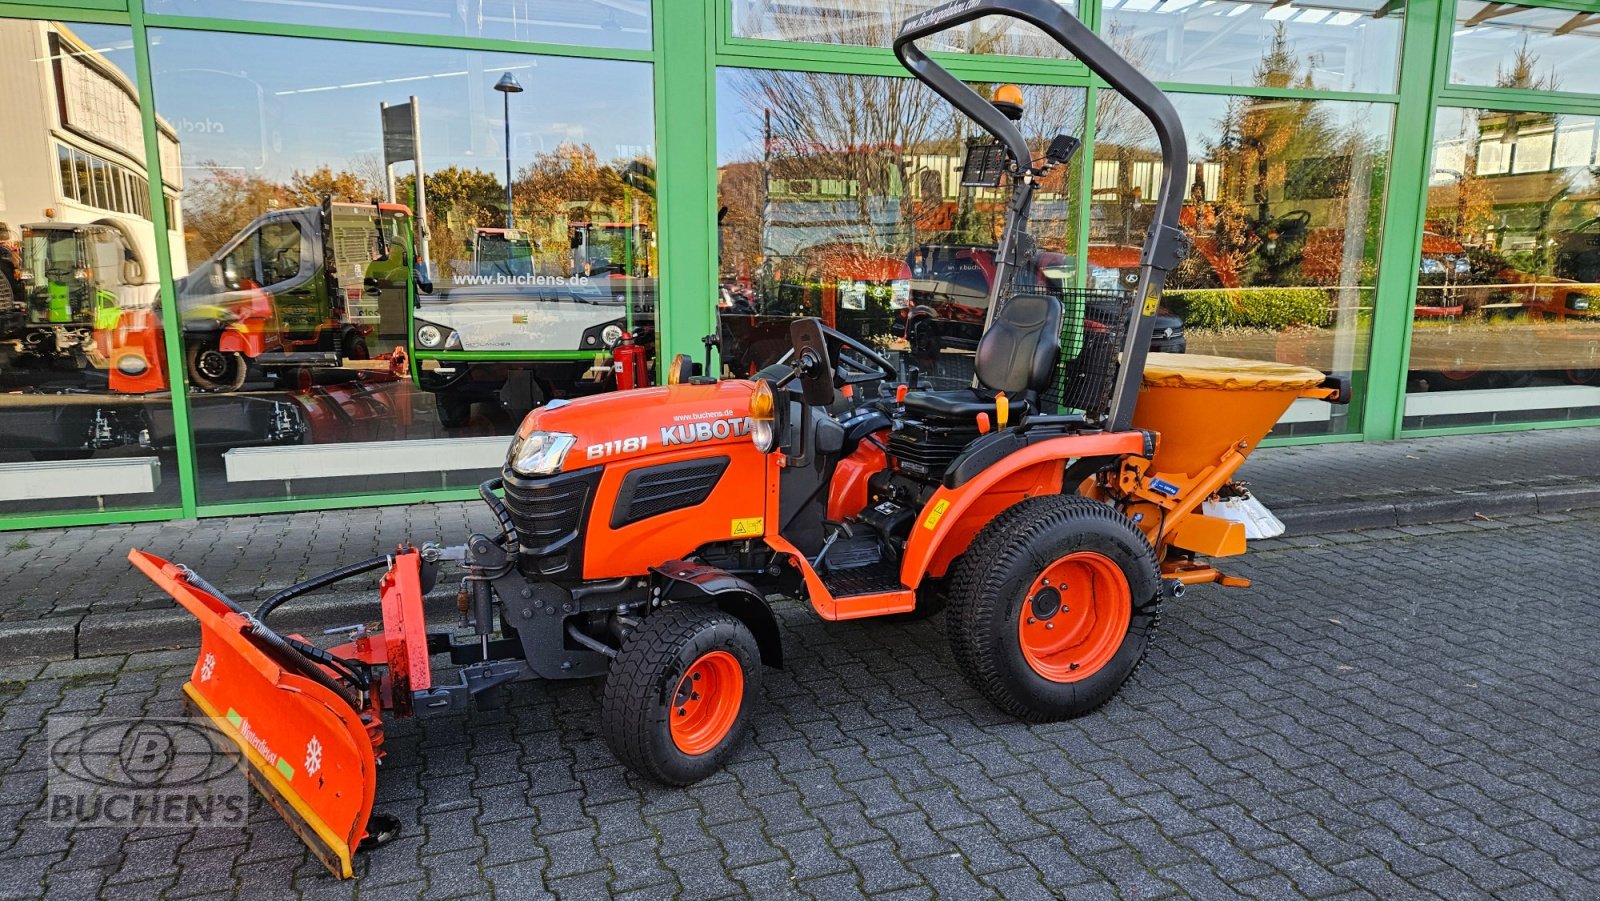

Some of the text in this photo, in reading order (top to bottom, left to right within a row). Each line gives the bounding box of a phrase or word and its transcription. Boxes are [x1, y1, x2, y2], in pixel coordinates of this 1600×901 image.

[166, 116, 225, 133] ubota
[453, 272, 589, 286] www.buchens.de
[673, 409, 734, 422] www.buchens.de
[586, 436, 648, 460] B1181
[240, 718, 277, 767] Winterdienst
